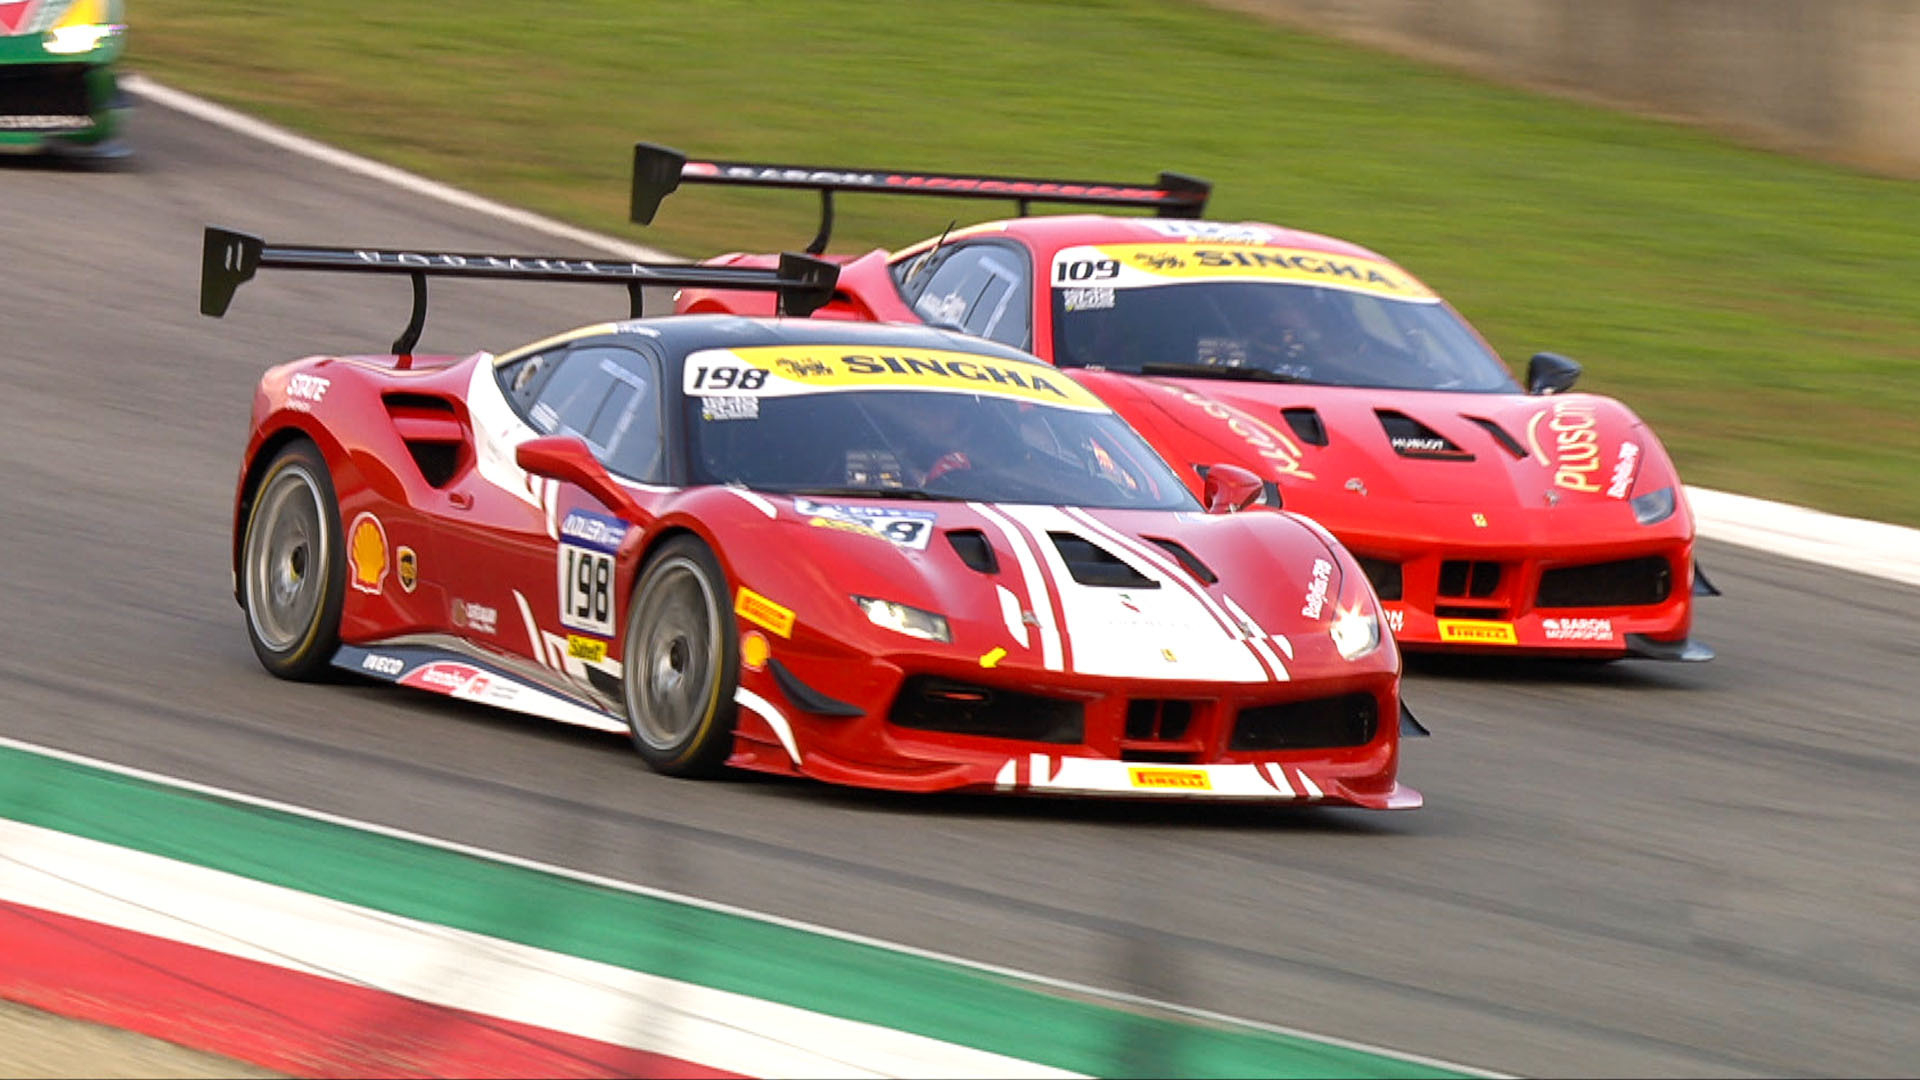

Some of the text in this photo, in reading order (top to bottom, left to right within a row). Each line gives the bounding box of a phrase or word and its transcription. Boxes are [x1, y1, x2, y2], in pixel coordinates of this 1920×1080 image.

[1055, 259, 1120, 282] 109
[1194, 250, 1399, 289] SINGHA
[691, 366, 771, 391] 198
[840, 354, 1069, 399] SINGHA
[565, 548, 610, 623] 198
[1449, 625, 1508, 639] PIRELLI
[361, 653, 405, 675] IVECO
[1136, 770, 1205, 788] PIRELLI
